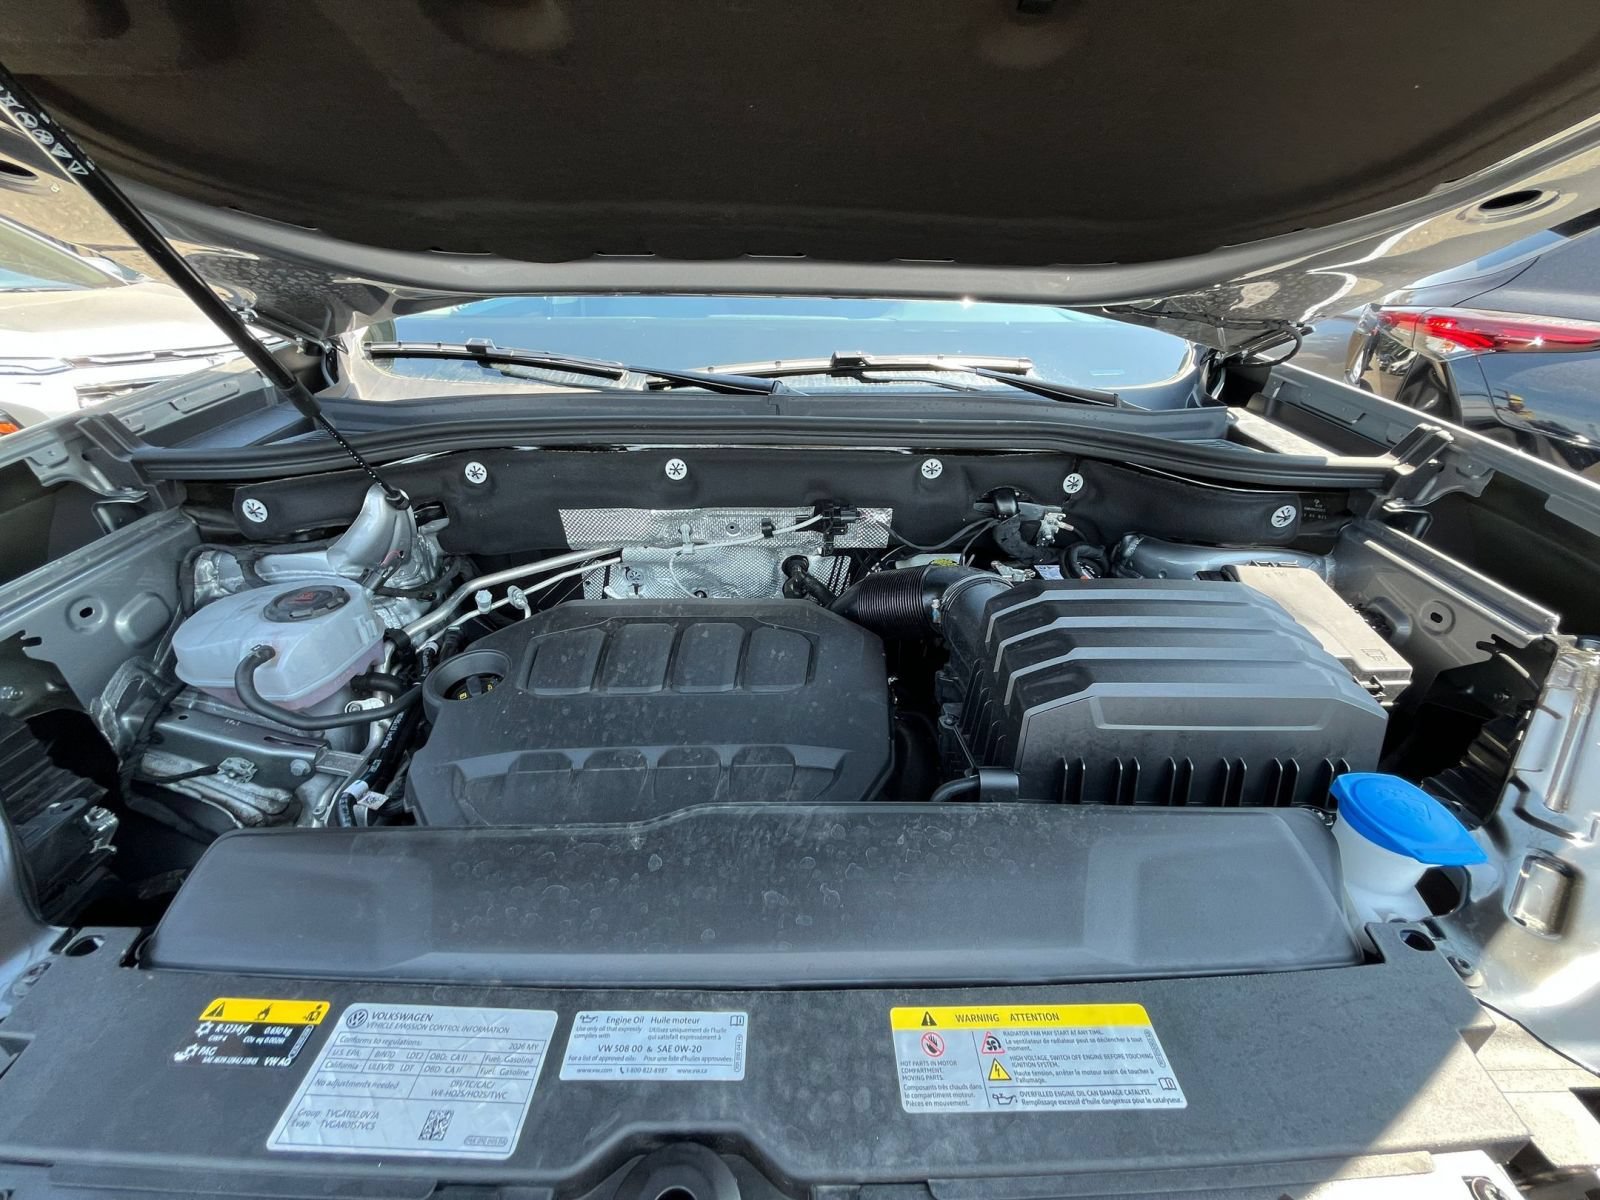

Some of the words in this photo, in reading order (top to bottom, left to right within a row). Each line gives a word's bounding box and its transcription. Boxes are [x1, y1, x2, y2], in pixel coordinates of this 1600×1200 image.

[371, 1011, 433, 1022] VOLKSWAGEN
[606, 1016, 632, 1025] Engine
[651, 1016, 670, 1024] Huile
[955, 1013, 999, 1023] WARNING
[1010, 1012, 1059, 1022] ATTENTION
[215, 1025, 252, 1037] R-1234yf
[394, 1023, 427, 1031] EMISSION
[429, 1024, 461, 1032] CONTROL
[461, 1025, 510, 1034] INFORMATION
[340, 1036, 372, 1044] Conforms
[197, 1046, 218, 1056] PAG
[598, 1044, 612, 1052] VW
[614, 1044, 630, 1052] 508
[657, 1045, 673, 1053] SAE
[674, 1045, 702, 1053] 0W-20
[429, 1053, 447, 1061] OBD:
[451, 1053, 460, 1061] CA
[504, 1055, 533, 1063] Gasoline
[264, 1057, 279, 1067] VW
[325, 1060, 359, 1070] California
[400, 1064, 414, 1072] LDT
[499, 1068, 529, 1076] Gasoline
[314, 1078, 325, 1087] No
[326, 1078, 370, 1089] adjustments
[371, 1081, 399, 1090] needed
[911, 1092, 949, 1100] compartiment
[1022, 1098, 1057, 1106] Remplissage
